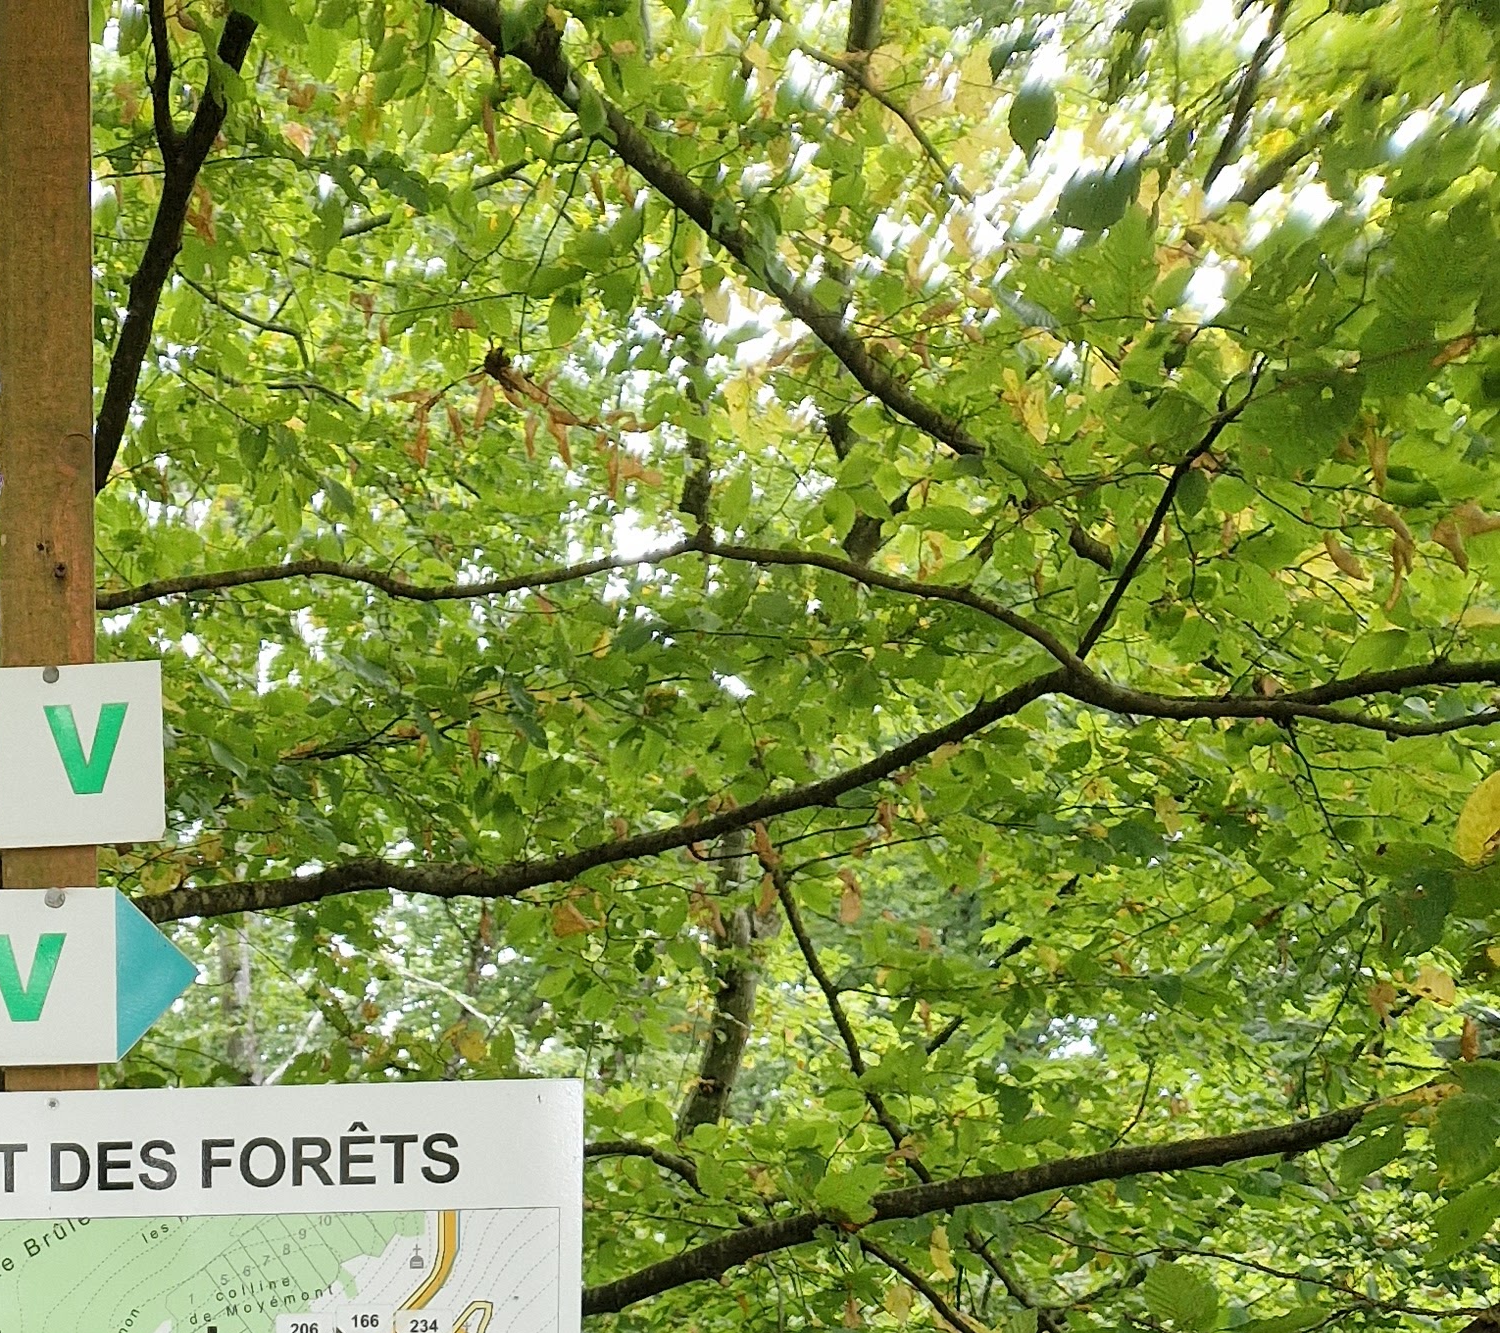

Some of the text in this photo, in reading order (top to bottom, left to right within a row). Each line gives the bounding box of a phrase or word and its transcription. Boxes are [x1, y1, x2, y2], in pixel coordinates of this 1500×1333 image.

[43, 703, 129, 794] V
[50, 1140, 178, 1192] DES
[201, 1121, 460, 1188] FORÊTS
[319, 1215, 332, 1226] 10
[142, 1222, 169, 1243] les
[299, 1229, 306, 1239] 9
[283, 1244, 290, 1255] 8
[263, 1255, 270, 1266] 7
[216, 1277, 289, 1301] colline
[190, 1285, 332, 1324] de Moyémont
[351, 1314, 379, 1328] 166
[409, 1318, 438, 1333] 234
